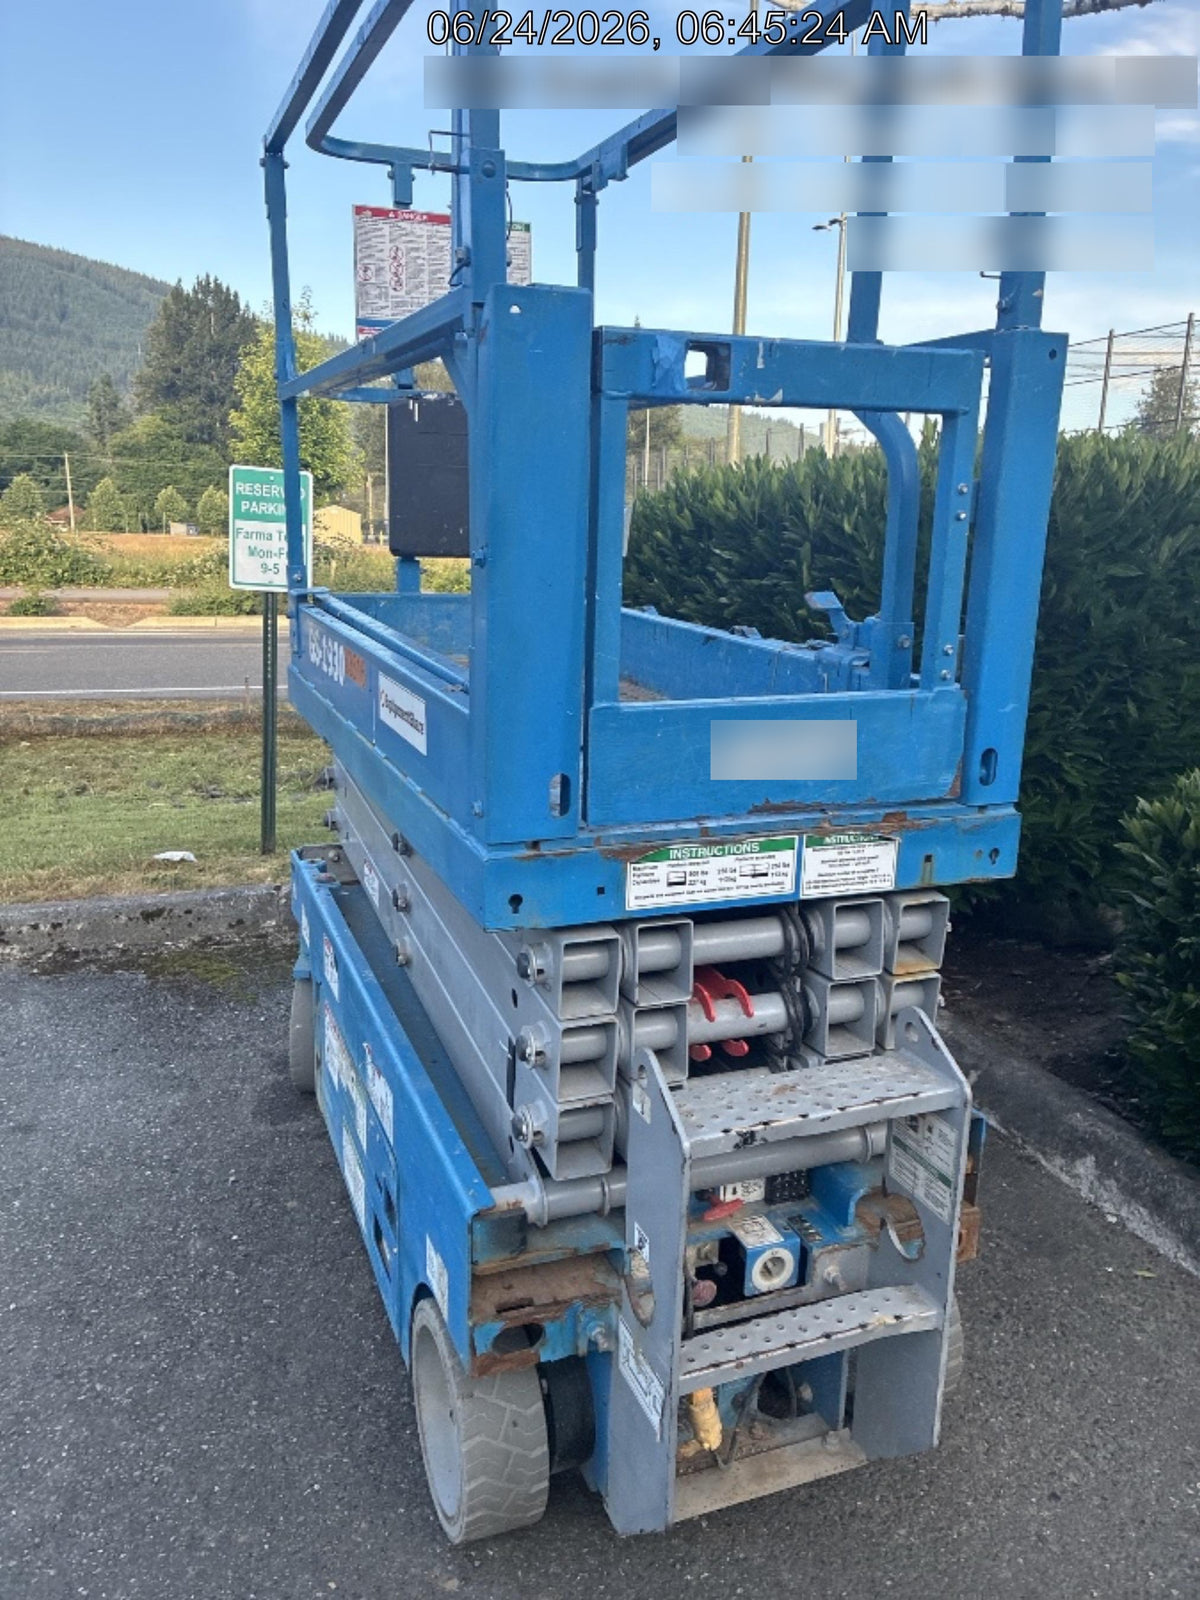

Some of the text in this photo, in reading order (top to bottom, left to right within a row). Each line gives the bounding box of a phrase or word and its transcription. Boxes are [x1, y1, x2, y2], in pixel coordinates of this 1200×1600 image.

[241, 500, 287, 516] PARKIN
[235, 527, 273, 541] Farma
[248, 545, 288, 560] Mon-F
[260, 561, 280, 575] 9-5
[669, 843, 760, 860] INSTRUCTIONS
